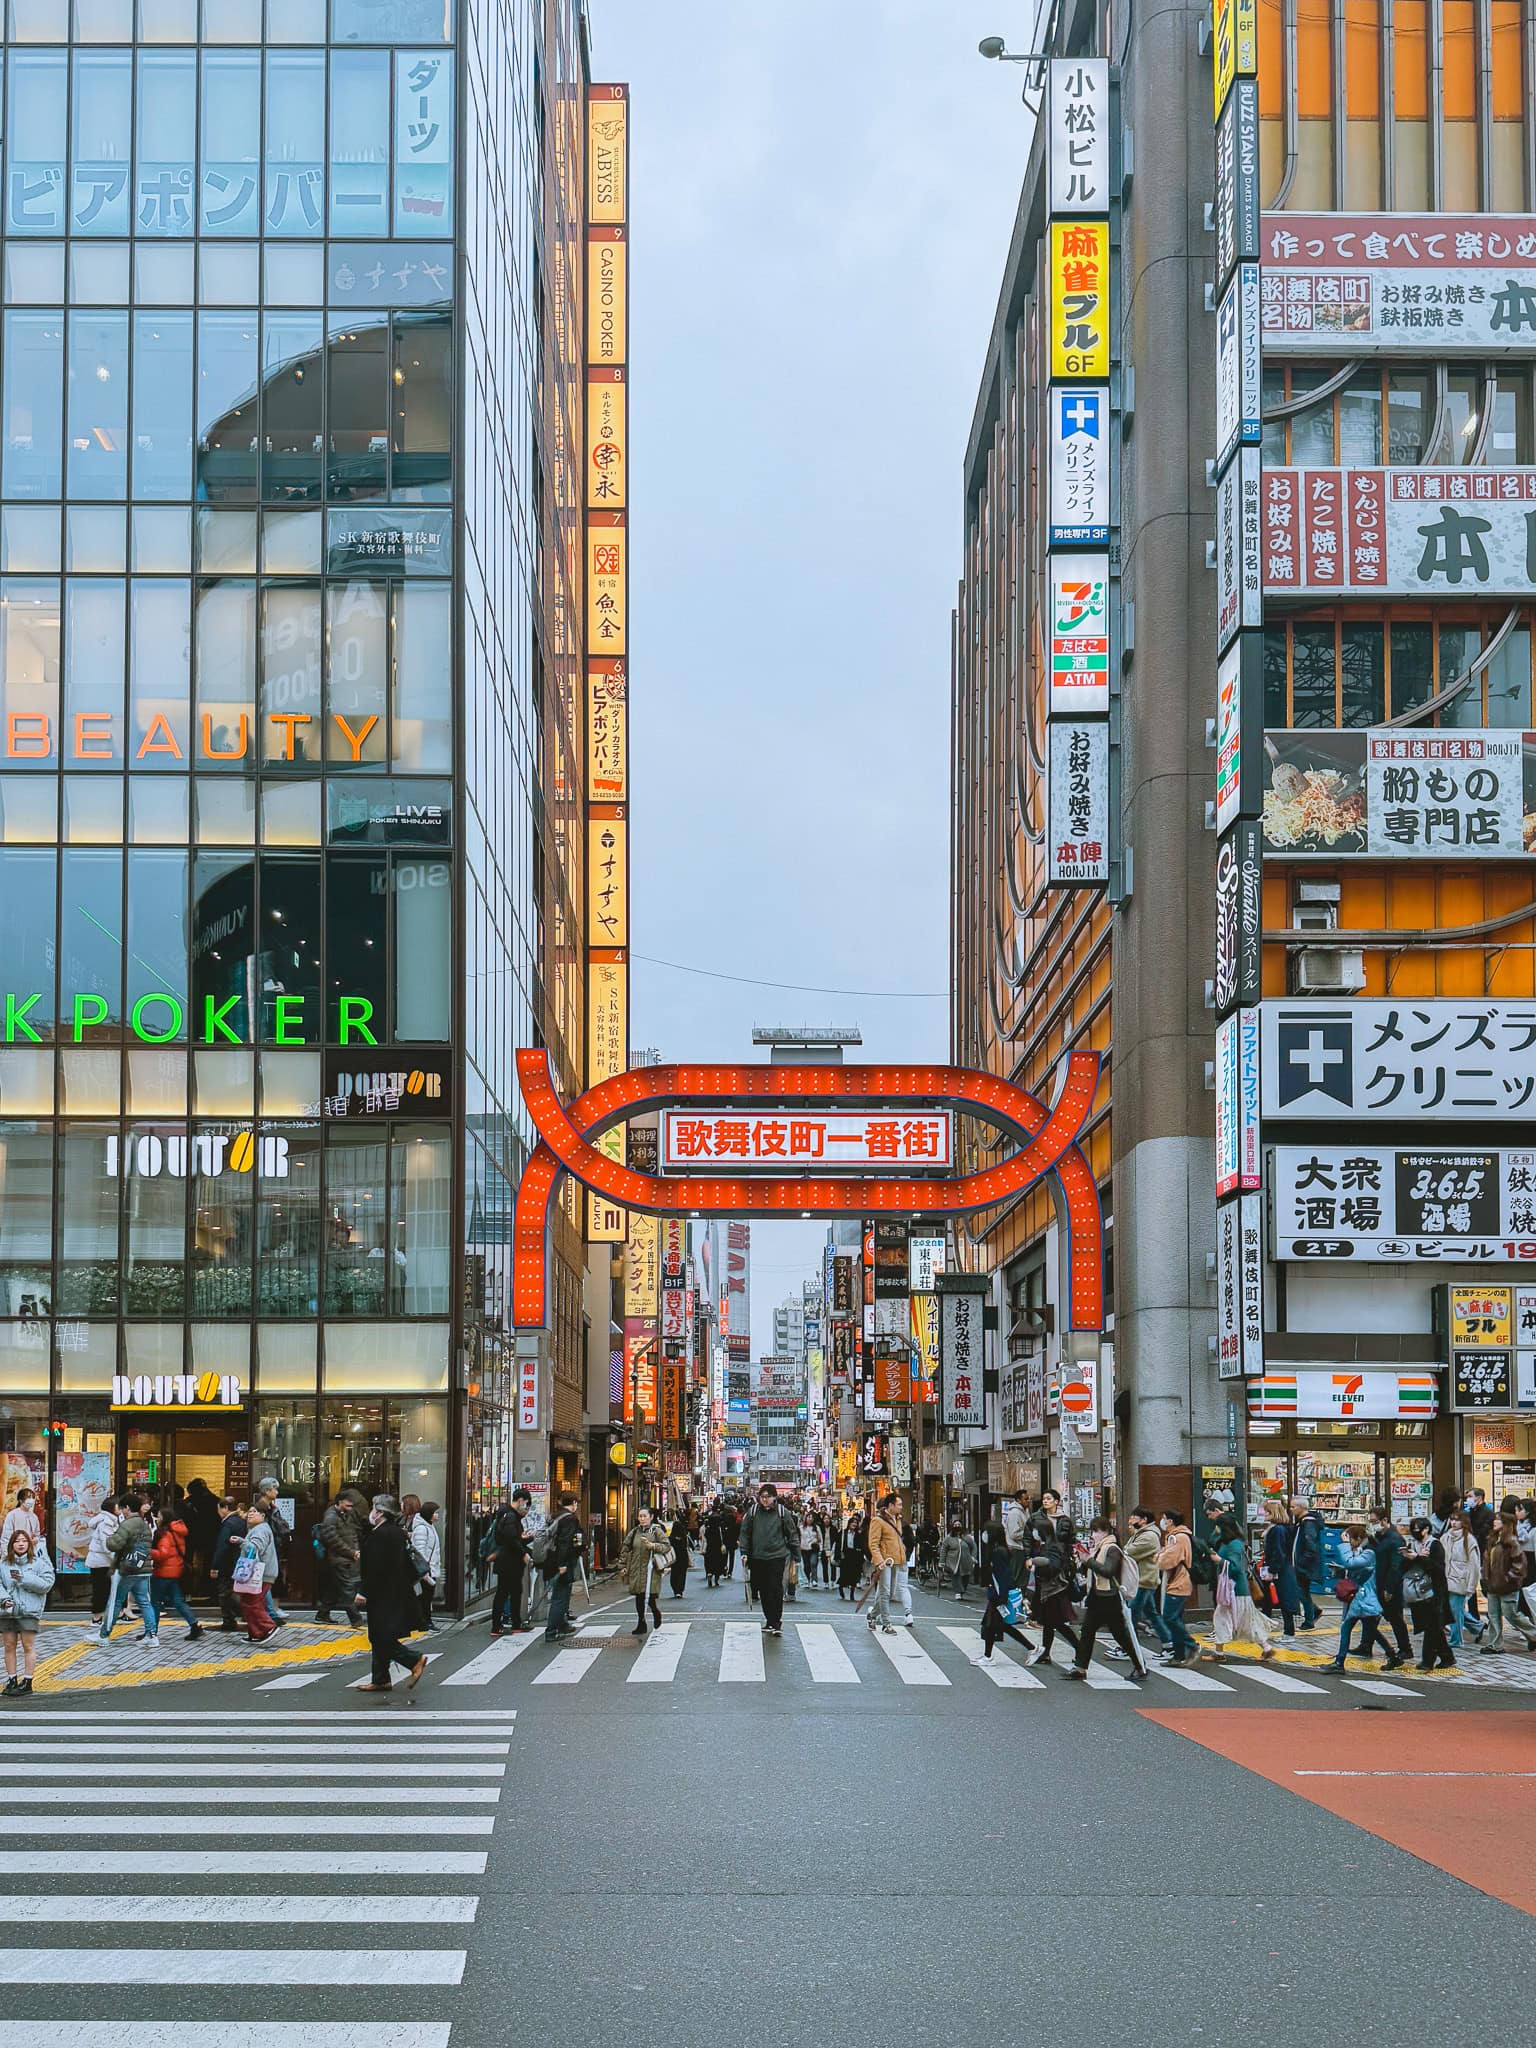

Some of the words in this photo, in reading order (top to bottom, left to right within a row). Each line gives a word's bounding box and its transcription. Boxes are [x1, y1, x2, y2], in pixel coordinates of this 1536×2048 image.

[1240, 21, 1253, 31] 6F
[406, 58, 441, 153] ダーツ
[609, 86, 623, 98] 10
[1240, 85, 1254, 122] BUZZ
[1064, 67, 1096, 202] 小松ビル
[1240, 124, 1255, 175] STAND
[597, 146, 612, 204] ABYSS
[10, 168, 383, 229] ビアポンバー
[613, 228, 622, 240] 9
[1270, 230, 1536, 260] 作って食べて楽しめ
[601, 247, 614, 306] CASINO
[1062, 226, 1099, 350] 麻雀ブル
[1261, 276, 1369, 302] 歌舞伎町
[1381, 284, 1486, 305] お好み焼き
[1261, 304, 1313, 328] 名物
[1380, 306, 1464, 327] 鉄板焼き
[601, 310, 614, 357] POKER
[1066, 355, 1095, 373] 6F
[1244, 286, 1257, 417] メンズライフクリニック
[613, 369, 622, 381] 8
[602, 391, 611, 425] ホルモン
[1243, 424, 1259, 434] 3F
[594, 444, 621, 498] 幸永
[1066, 442, 1079, 510] クリニック
[1082, 442, 1095, 523] メンズライフ
[612, 514, 622, 525] 7
[1054, 528, 1090, 539] 男性専門
[1092, 528, 1107, 539] 3F
[1245, 480, 1258, 591] 歌舞伎町名物
[1267, 477, 1294, 580] お好み焼
[1311, 477, 1338, 579] たこ焼き
[1354, 475, 1380, 581] もんじゃ焼き
[338, 531, 357, 545] SK
[1416, 506, 1536, 584] 本
[595, 592, 621, 638] 魚金
[1062, 639, 1099, 653] たばこ
[613, 660, 622, 672] 6
[1072, 656, 1088, 669] 酒
[1064, 673, 1096, 685] ATM
[7, 712, 379, 762] BEAUTY
[611, 735, 621, 767] カラオケ
[1372, 740, 1484, 758] 歌舞伎町名物
[1487, 743, 1519, 756] HONJIN
[1069, 730, 1091, 837] お好み焼き
[1383, 766, 1499, 803] 粉もの
[614, 806, 623, 818] 5
[1383, 808, 1500, 845] 専門店
[1056, 840, 1103, 864] 本陣
[1058, 865, 1099, 877] HONJIN
[613, 950, 623, 961] 4
[337, 1069, 442, 1099] DOUTOR
[1241, 1026, 1257, 1126] ファイトフィット
[1365, 1065, 1535, 1110] クリニッ
[676, 1120, 940, 1157] 歌舞伎町一番街
[1295, 1156, 1384, 1192] 大衆
[1295, 1197, 1383, 1232] 酒場
[1421, 1202, 1472, 1232] 酒場
[1306, 1241, 1341, 1255] 2F
[664, 1278, 684, 1288] B1F
[919, 1247, 931, 1288] 東南荘
[1244, 1229, 1260, 1342] 歌舞伎町名物
[643, 1319, 657, 1328] 2F
[955, 1298, 971, 1371] お好み焼き
[1465, 1319, 1497, 1334] ブル
[1496, 1335, 1508, 1343] 6F
[112, 1371, 240, 1405] DOUTOR
[523, 1363, 535, 1424] 劇場通り
[955, 1374, 972, 1410] 本陣
[1469, 1379, 1495, 1394] 酒場
[1474, 1397, 1492, 1405] 2F
[948, 1413, 979, 1422] HONJIN
[726, 1437, 750, 1447] SAUNA
[1392, 1482, 1416, 1494] たばこ
